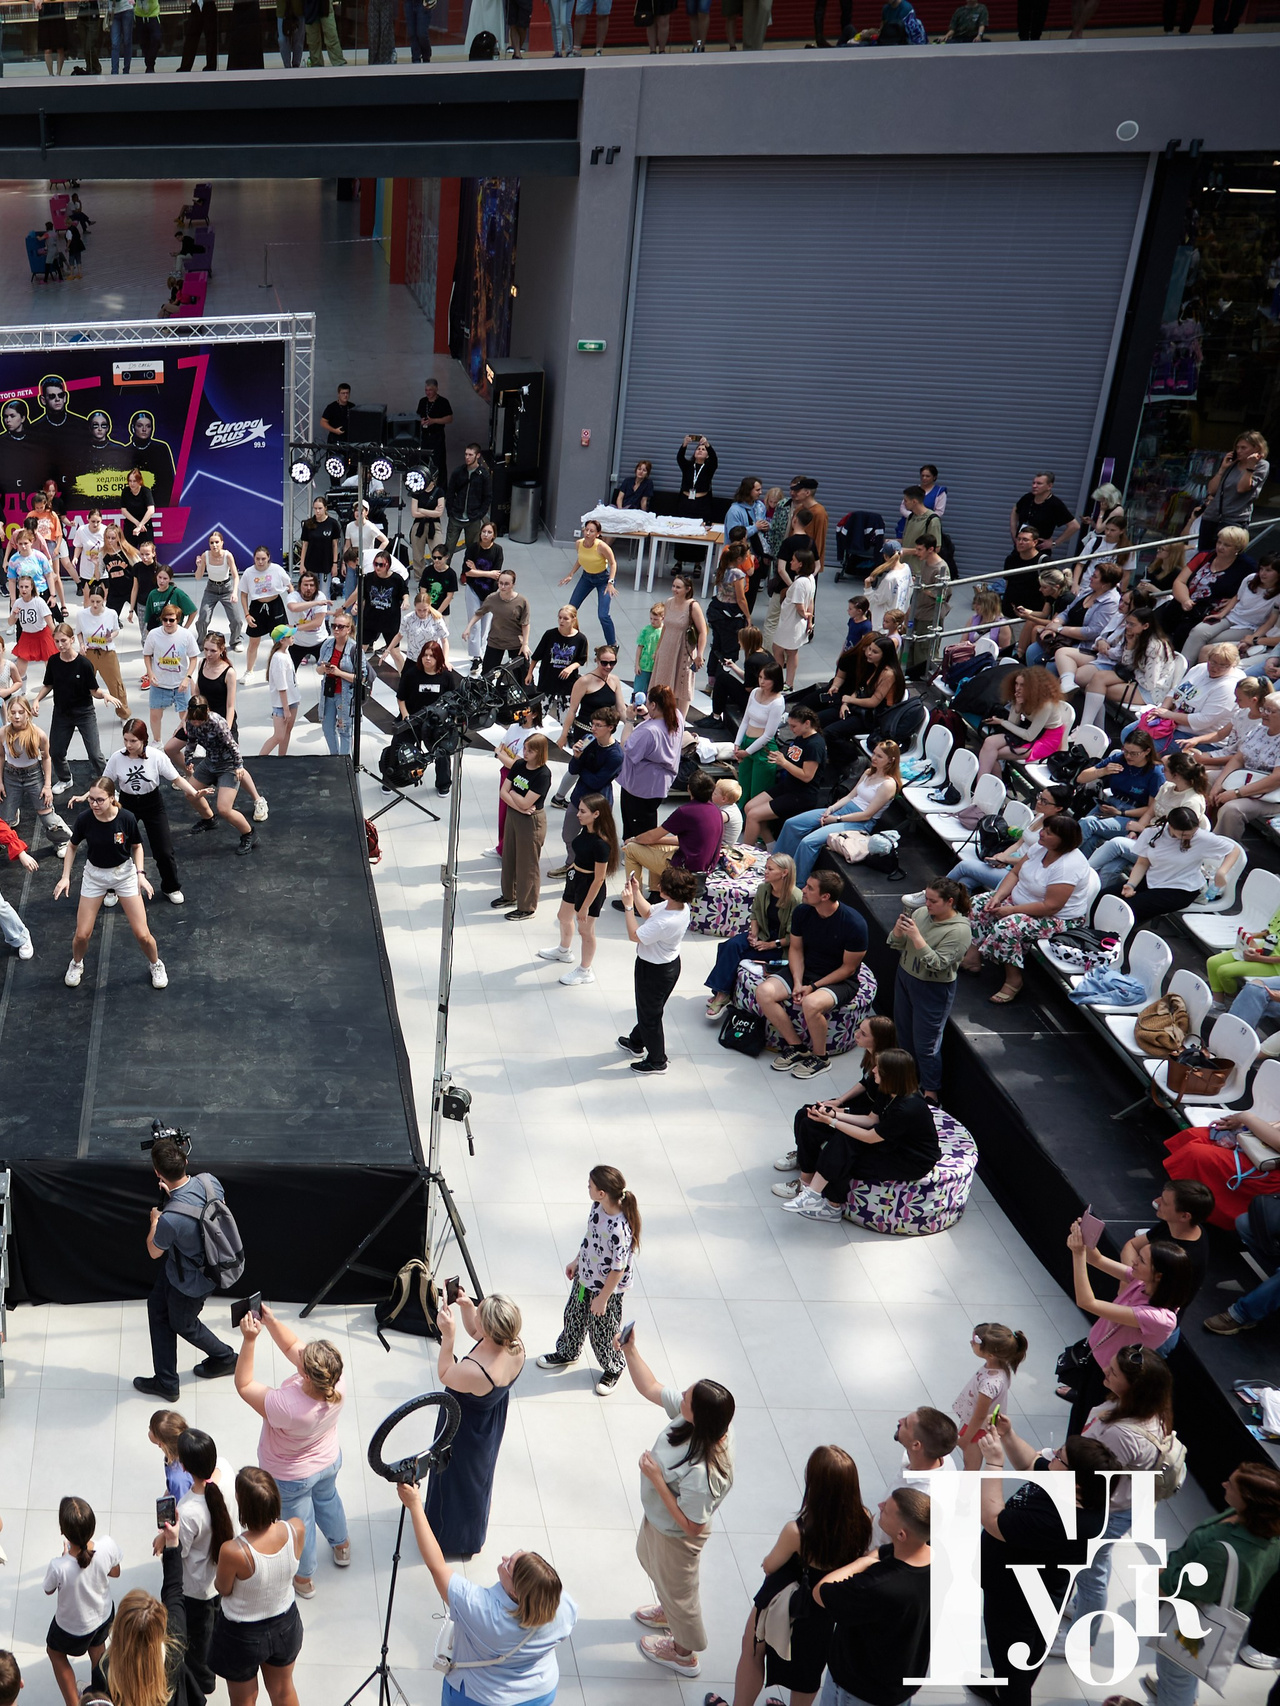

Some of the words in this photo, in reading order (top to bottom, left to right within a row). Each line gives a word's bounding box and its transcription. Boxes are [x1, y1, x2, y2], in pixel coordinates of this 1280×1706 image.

[17, 389, 33, 397] ЛЕТА
[205, 418, 260, 437] Europa
[253, 441, 266, 449] 99.9
[96, 475, 127, 483] хедлайн
[20, 608, 37, 625] 13
